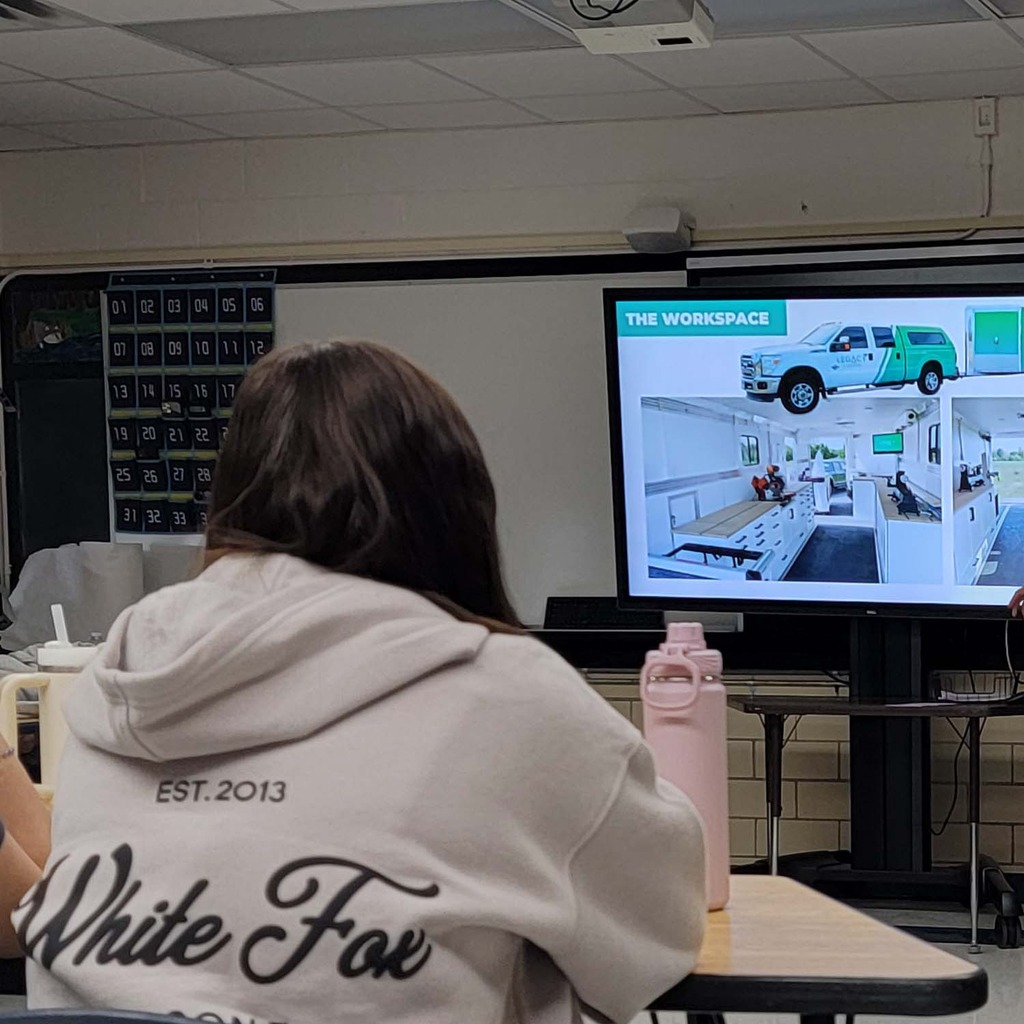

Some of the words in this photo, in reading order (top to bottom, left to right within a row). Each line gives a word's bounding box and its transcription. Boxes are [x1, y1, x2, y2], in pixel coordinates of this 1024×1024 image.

[111, 299, 127, 315] 01
[140, 299, 155, 314] 02
[167, 298, 181, 314] 03
[194, 298, 209, 313] 04
[222, 297, 237, 312] 05
[250, 297, 264, 312] 06
[625, 312, 658, 326] THE
[662, 311, 770, 326] WORKSPACE
[113, 342, 126, 357] 07
[140, 341, 154, 356] 08
[168, 341, 182, 356] 09
[195, 340, 210, 355] 10
[223, 340, 238, 355] 11
[250, 340, 266, 356] 12
[112, 384, 128, 399] 13
[142, 384, 155, 398] 14
[168, 383, 182, 398] 15
[193, 383, 208, 398] 16
[221, 383, 235, 398] 17
[113, 426, 128, 441] 19
[141, 426, 156, 440] 20
[168, 427, 184, 442] 21
[194, 427, 210, 442] 22
[115, 467, 131, 482] 25
[143, 469, 158, 484] 26
[173, 467, 185, 481] 27
[197, 467, 212, 482] 28
[123, 507, 137, 522] 31
[146, 509, 162, 523] 32
[172, 511, 187, 525] 33
[14, 843, 232, 970] White
[239, 855, 440, 984] Fox
